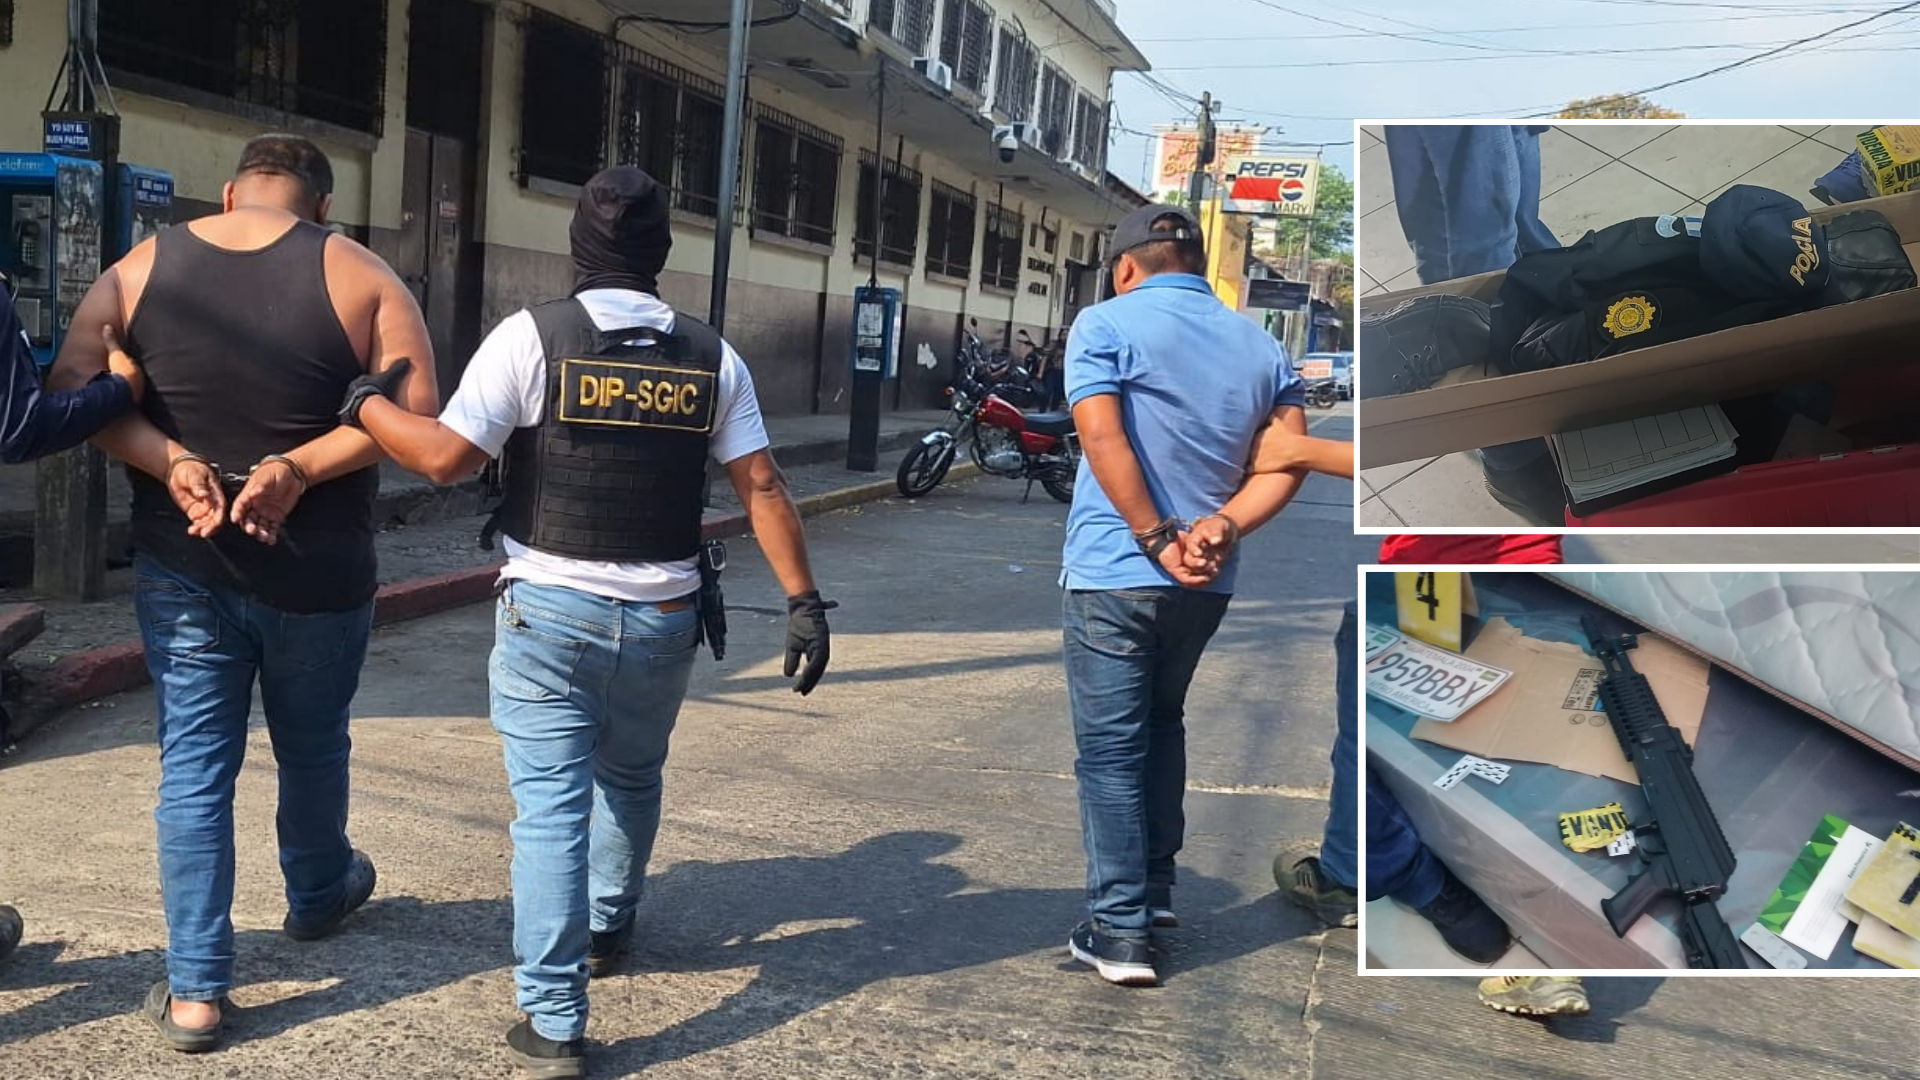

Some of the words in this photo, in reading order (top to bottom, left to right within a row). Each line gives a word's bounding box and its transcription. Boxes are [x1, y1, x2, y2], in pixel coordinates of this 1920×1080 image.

[51, 123, 61, 132] YO
[62, 123, 75, 133] SOY
[76, 123, 84, 133] EL
[1237, 161, 1308, 179] PEPSI
[579, 374, 698, 416] DIP-SGIC
[1416, 572, 1440, 621] 4
[1405, 643, 1455, 667] GUATEMALA
